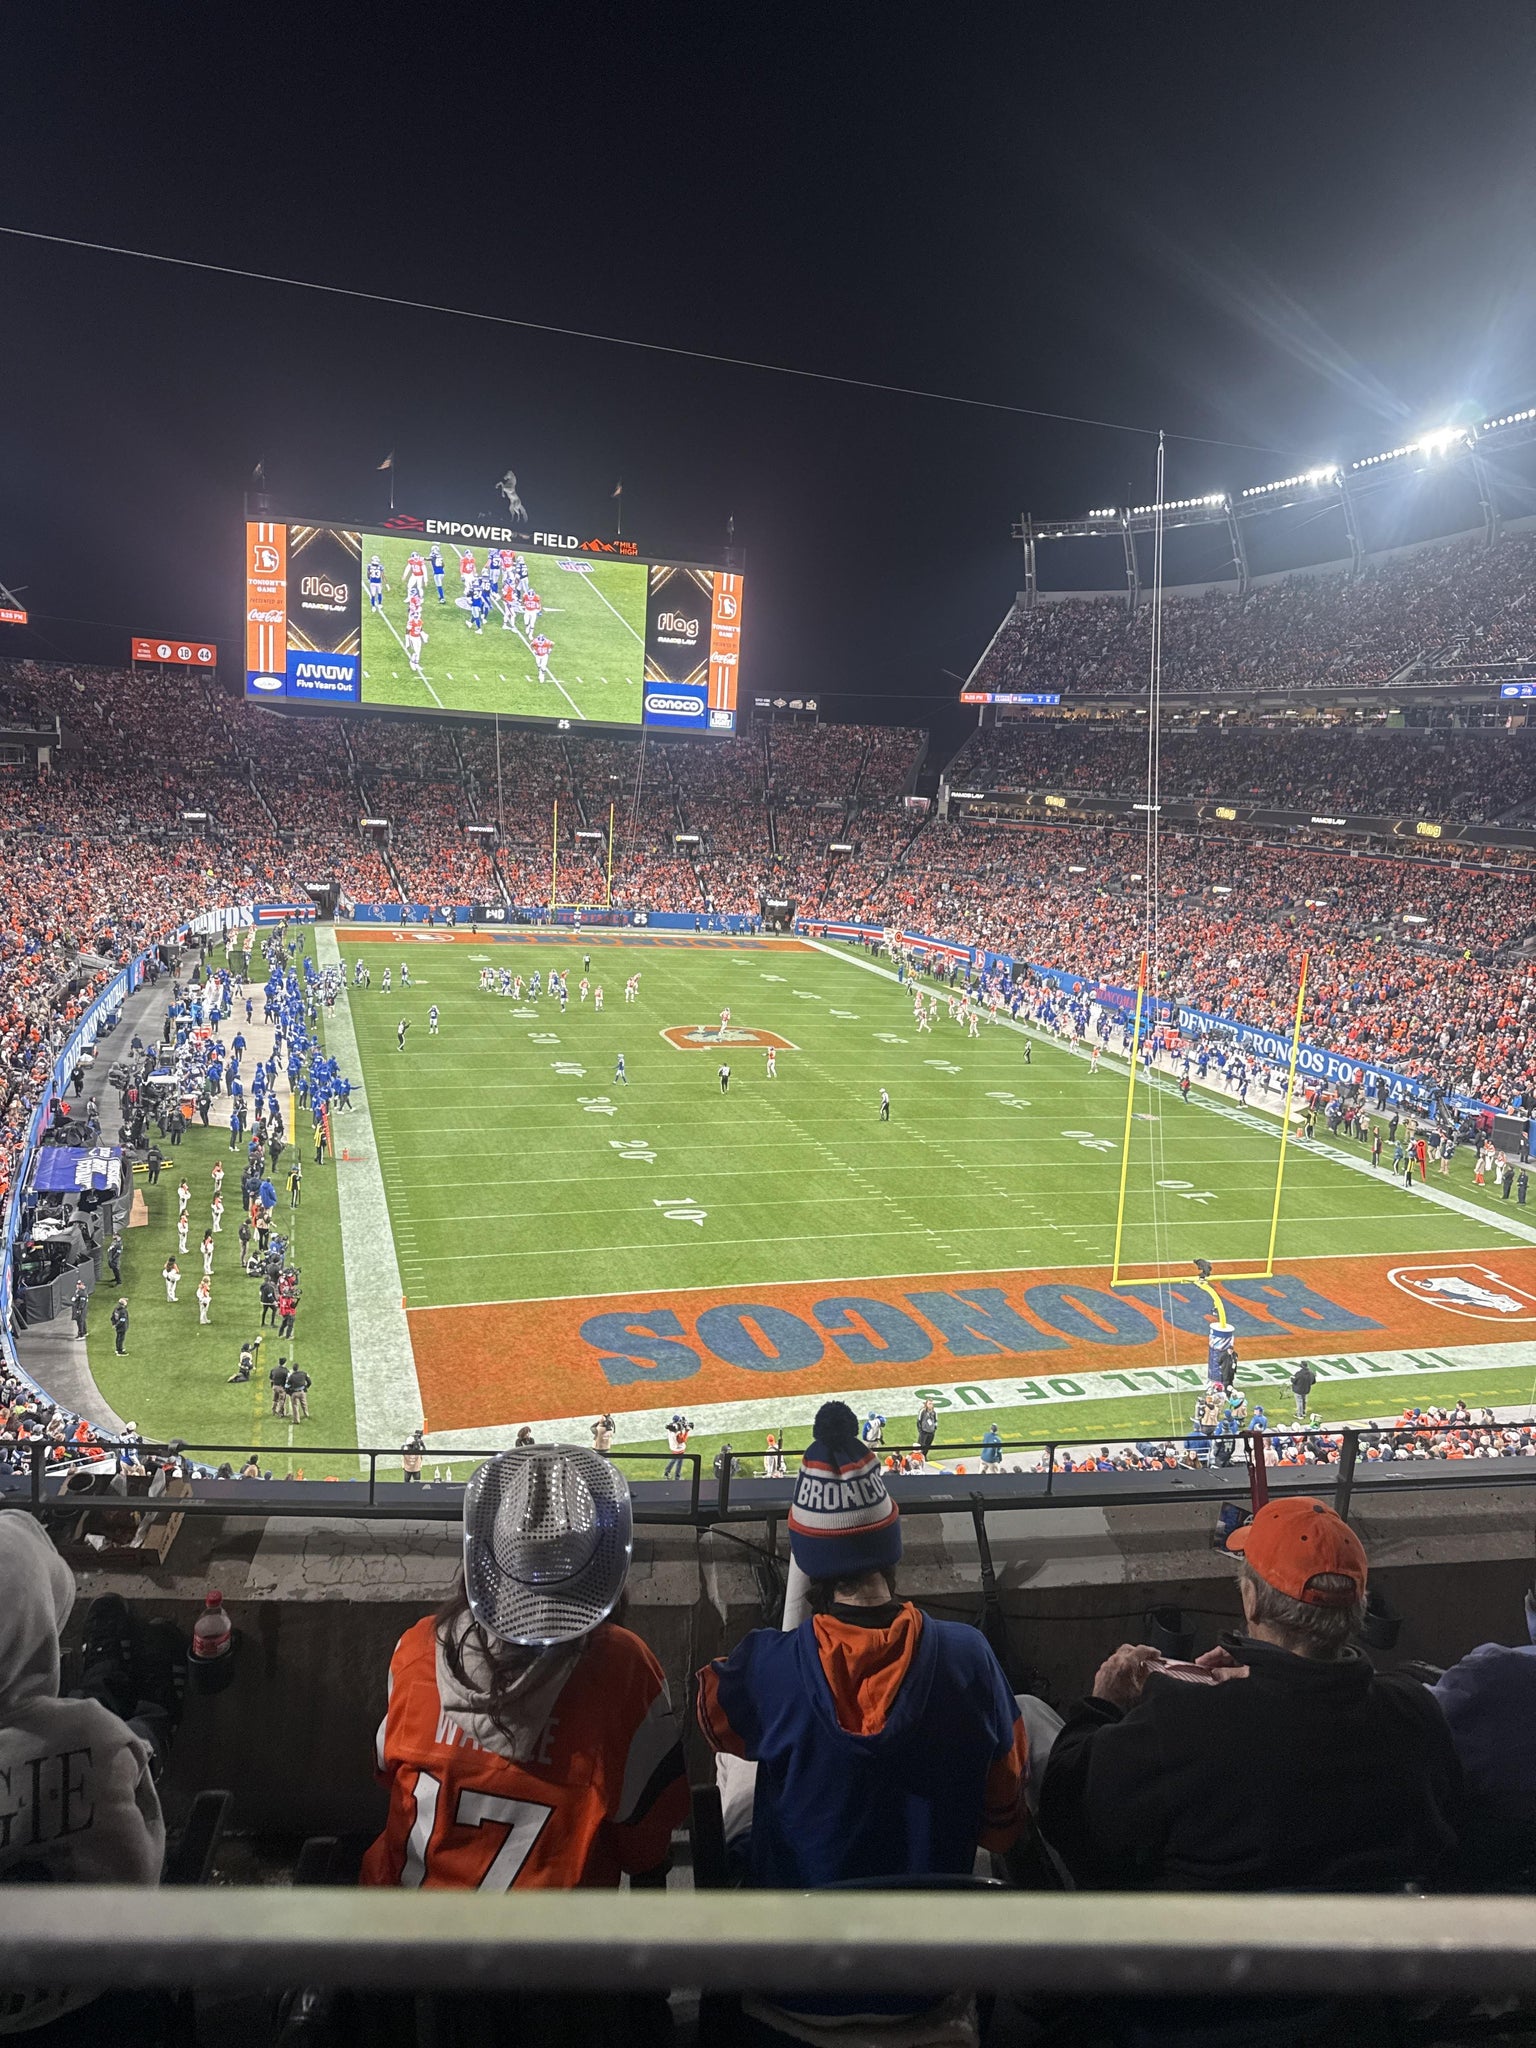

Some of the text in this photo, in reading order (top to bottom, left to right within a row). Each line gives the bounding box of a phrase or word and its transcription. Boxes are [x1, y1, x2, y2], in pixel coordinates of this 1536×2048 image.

[426, 519, 579, 549] EMPOWER FIELD
[619, 541, 638, 549] MILE
[619, 548, 638, 556] HIGH
[301, 576, 348, 604] flag
[330, 604, 347, 612] LAW
[657, 613, 699, 637] flag
[180, 648, 190, 658] 18
[199, 650, 210, 660] 44
[296, 663, 354, 681] ARROW
[296, 679, 353, 691] Five Years Out
[1311, 816, 1346, 826] RAMOS LAW
[1416, 821, 1442, 838] flag
[1241, 1031, 1324, 1073] BRONCOS
[576, 1096, 618, 1113] 30
[608, 1139, 658, 1160] 20
[652, 1197, 708, 1221] 10
[579, 1273, 1388, 1387] BRONCOS
[1402, 1351, 1458, 1369] IT
[1016, 1378, 1086, 1400] OF
[1099, 1368, 1204, 1392] ALL
[914, 1385, 996, 1409] US
[400, 1770, 555, 1893] 17
